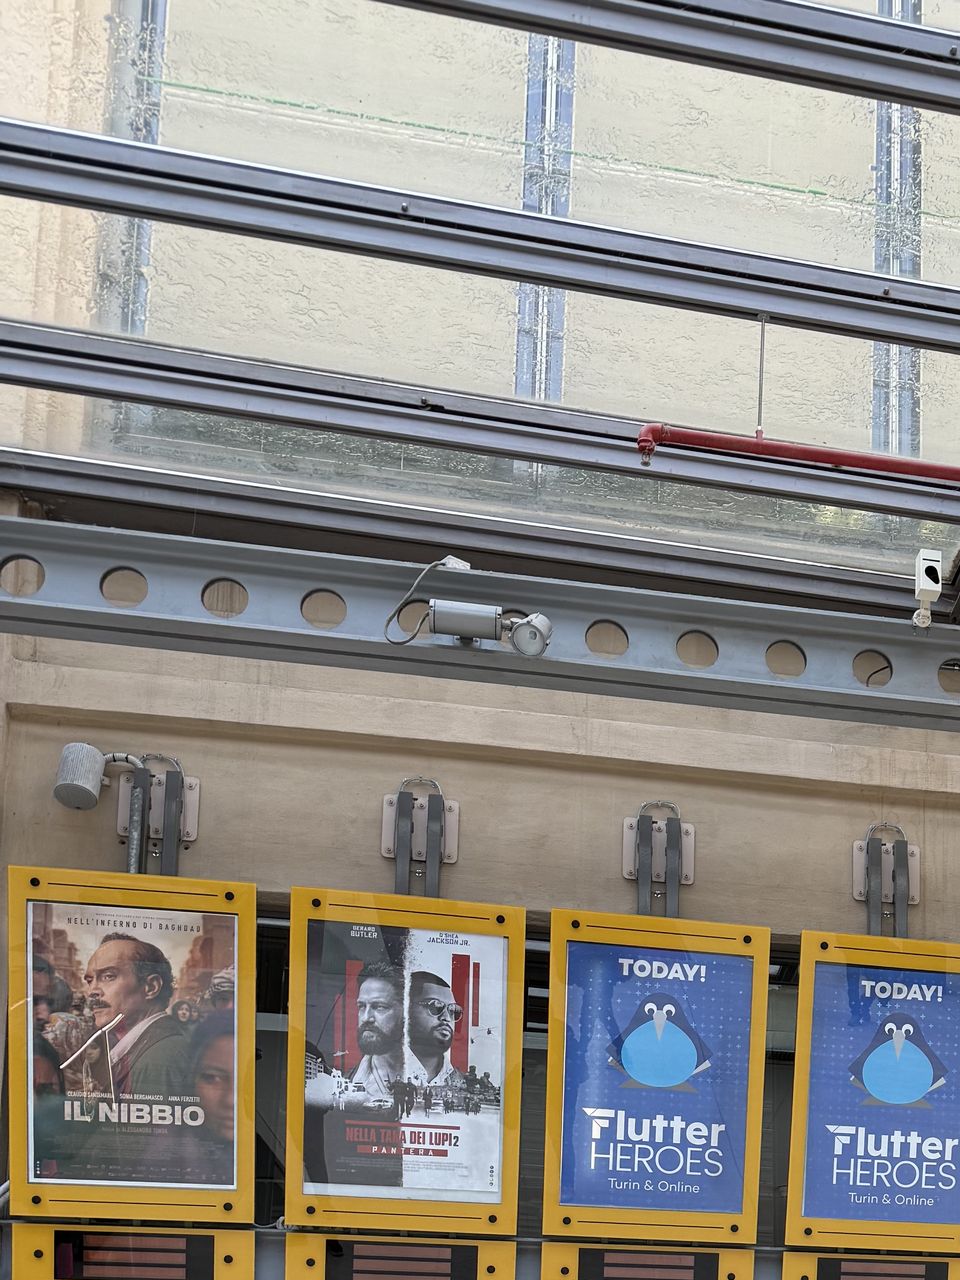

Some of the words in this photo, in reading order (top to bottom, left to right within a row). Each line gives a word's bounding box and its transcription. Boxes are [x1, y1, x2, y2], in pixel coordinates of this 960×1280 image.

[350, 930, 378, 939] BUTLER
[426, 937, 459, 946] JACKSON
[618, 958, 706, 983] TODAY!
[861, 980, 943, 1003] TODAY!
[64, 1100, 91, 1122] IL
[98, 1102, 205, 1127] NIBBIO
[582, 1107, 726, 1147] Flutter
[372, 1145, 434, 1156] PANTERA
[409, 1131, 426, 1145] DEI
[429, 1132, 453, 1147] LUPI
[453, 1135, 460, 1147] 2
[824, 1124, 959, 1161] Flutter
[589, 1142, 724, 1177] HEROES
[832, 1157, 957, 1190] HEROES
[607, 1178, 640, 1191] Turin
[643, 1180, 654, 1191] &
[657, 1180, 700, 1194] Online
[848, 1192, 879, 1205] Turin
[881, 1194, 892, 1205] &
[894, 1194, 934, 1207] Online
